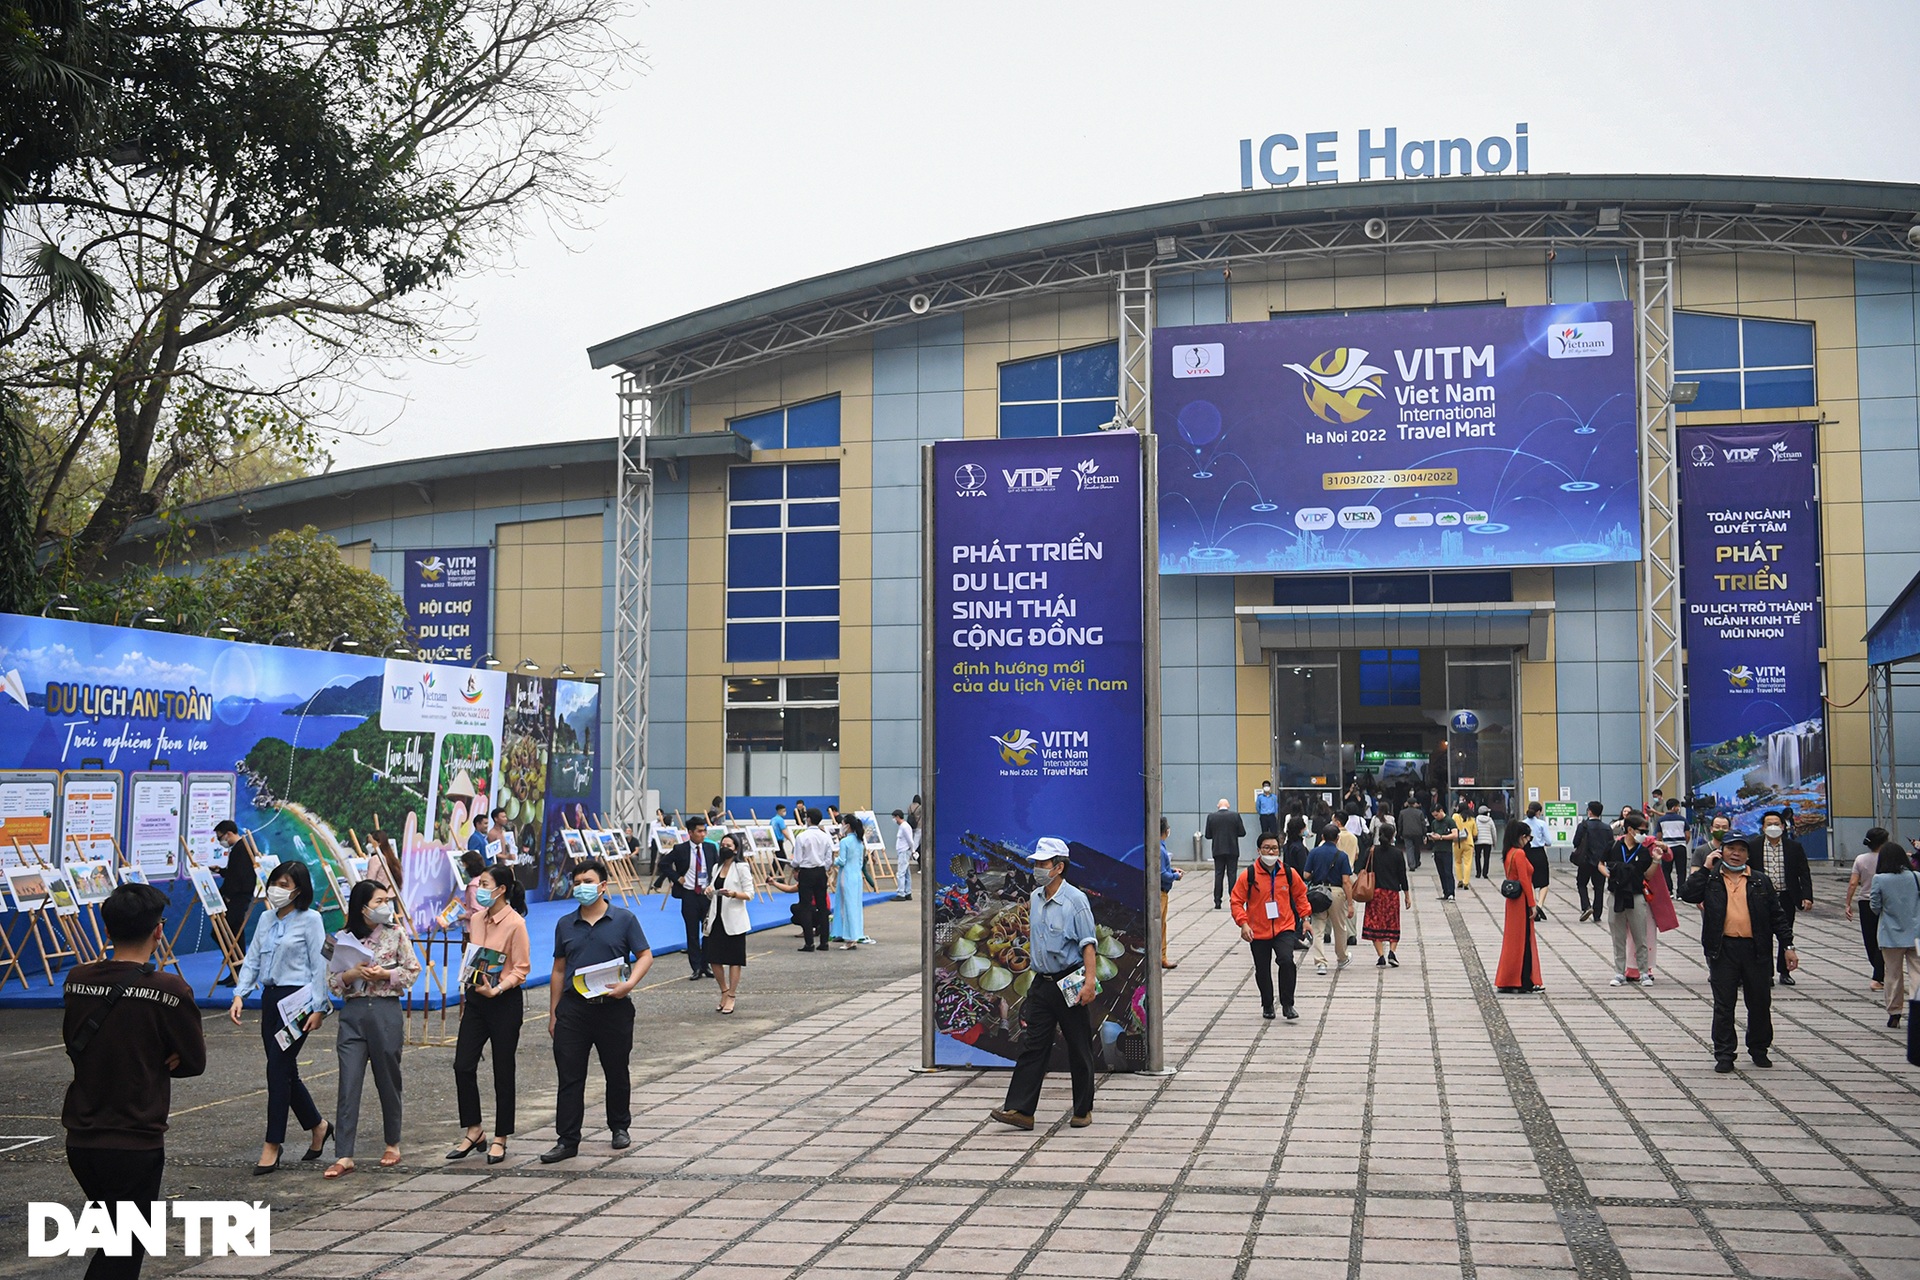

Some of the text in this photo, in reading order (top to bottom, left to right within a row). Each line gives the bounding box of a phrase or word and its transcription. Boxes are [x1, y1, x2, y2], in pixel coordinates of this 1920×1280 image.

[1240, 122, 1528, 189] ICE Hanoi
[1555, 336, 1605, 354] Vietnam
[1394, 345, 1495, 382] VITM
[1394, 383, 1495, 405] Viet Nam
[1400, 403, 1496, 422] International
[1306, 429, 1386, 444] Ha Noi 2022
[1397, 421, 1496, 440] Travel Mart
[1723, 448, 1760, 460] VTDF
[1002, 467, 1062, 487] VTDF
[1071, 469, 1120, 491] Vietnam
[1327, 475, 1385, 485] 31/03/2022
[1393, 472, 1453, 483] 03/04/2022
[1301, 513, 1328, 522] VTDF
[1343, 511, 1375, 521] VISTA
[1707, 508, 1790, 521] TOÀN NGÀNH
[1714, 520, 1787, 533] QUYẾT TÂM
[953, 532, 1103, 563] PHÁT TRIỂN
[1716, 540, 1783, 562] PHÁT
[447, 556, 476, 568] VITM
[953, 572, 1048, 593] DU LỊCH
[1714, 565, 1788, 591] TRIỂN
[419, 599, 472, 617] HỘI CHỢ
[953, 593, 1076, 619] SINH THÁI
[1691, 600, 1813, 614] DU LỊCH TRỞ THÀNH
[1704, 611, 1801, 626] NGÀNH KINH TẾ
[420, 625, 469, 640] DU LỊCH
[953, 618, 1103, 650] CỘNG ĐỒNG
[1720, 627, 1784, 639] MŨI NHỌN
[456, 644, 472, 660] TẾ
[953, 660, 1085, 678] định hướng mới
[1755, 666, 1785, 676] VITM
[392, 686, 414, 700] VTDF
[953, 678, 1128, 694] của du lịch Việt Nam
[47, 685, 212, 721] DU LỊCH AN TOÀN
[1041, 731, 1088, 747] VITM
[385, 736, 424, 782] Live fully
[1041, 749, 1088, 759] Viet Nam
[1044, 759, 1088, 767] International
[1042, 767, 1088, 776] Travel Mart
[414, 910, 426, 925] in
